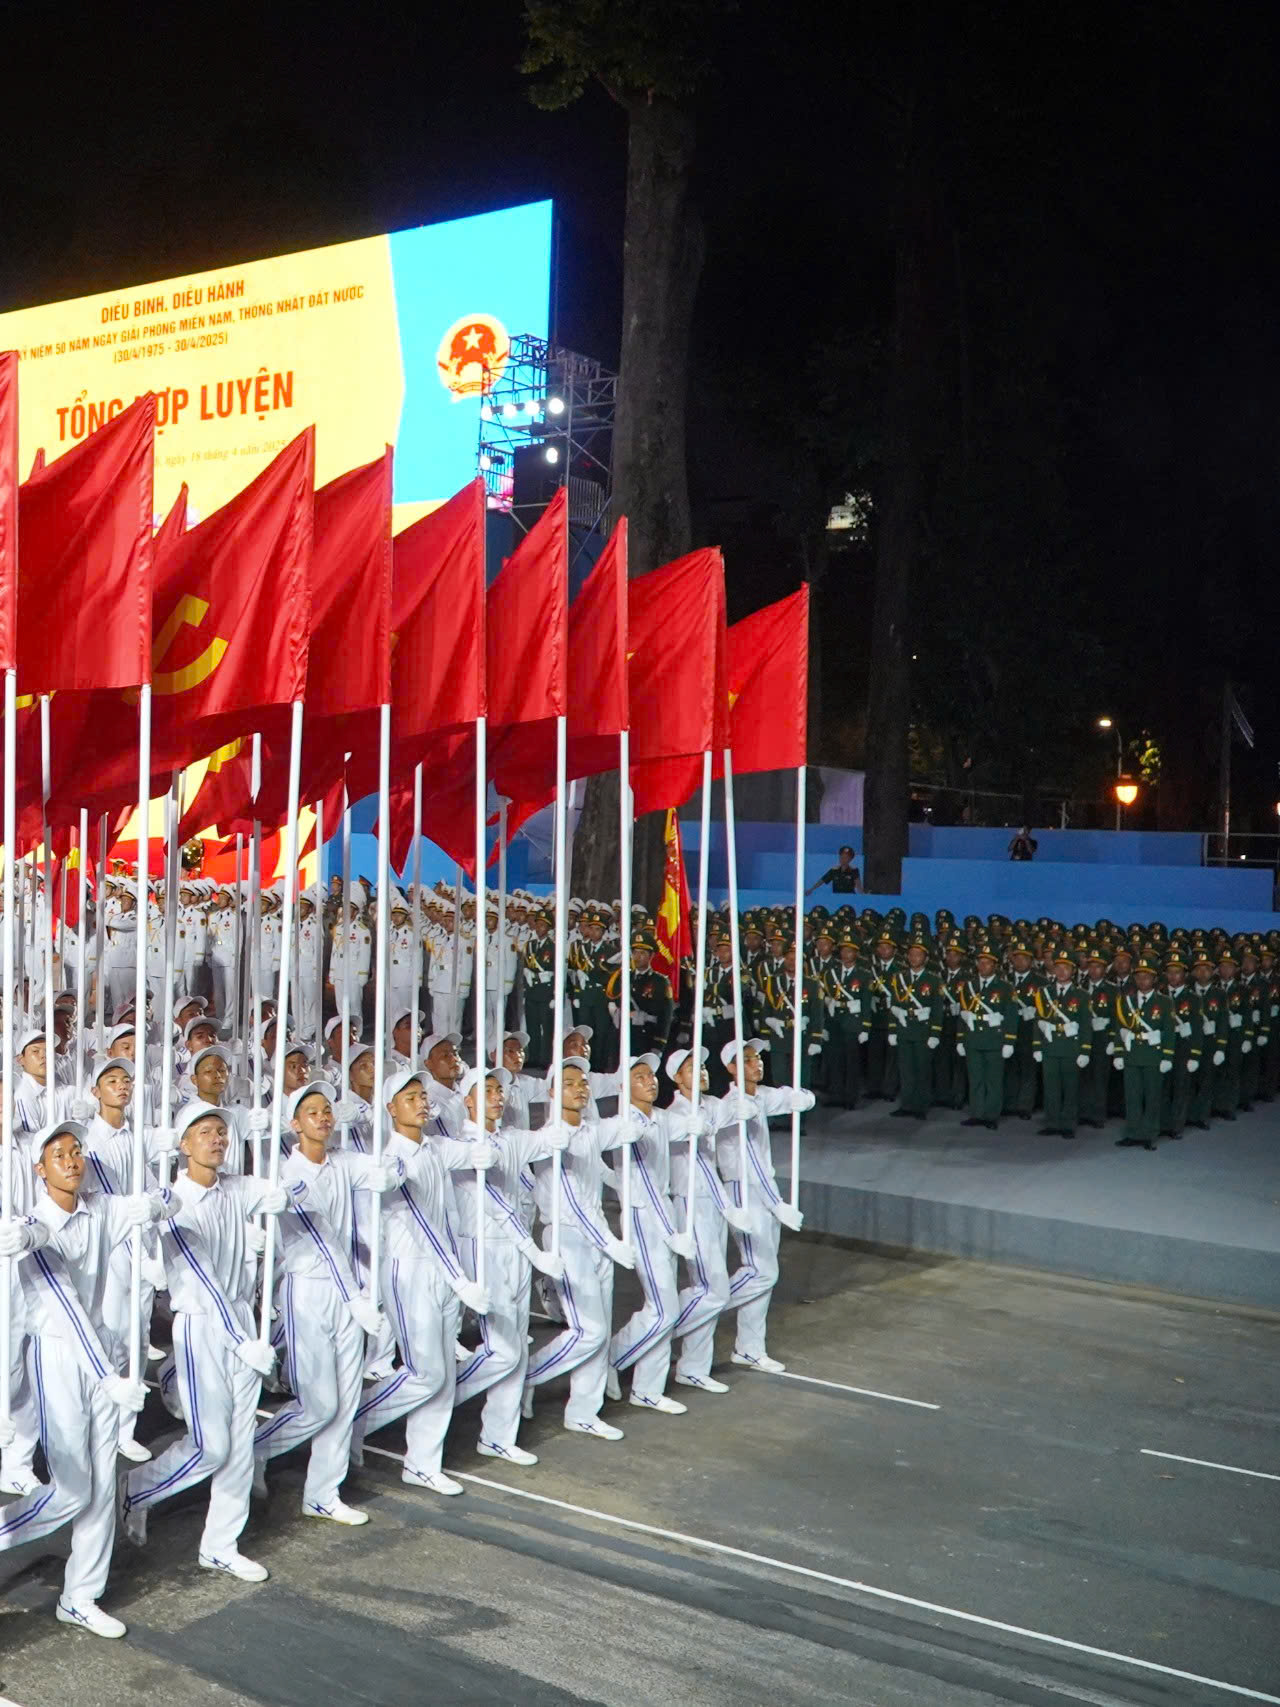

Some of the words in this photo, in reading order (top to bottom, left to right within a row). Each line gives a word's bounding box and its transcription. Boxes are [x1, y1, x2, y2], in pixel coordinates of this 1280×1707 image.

[55, 342, 66, 355] 50
[135, 387, 189, 436] ỢP
[200, 367, 294, 421] LUYỆN
